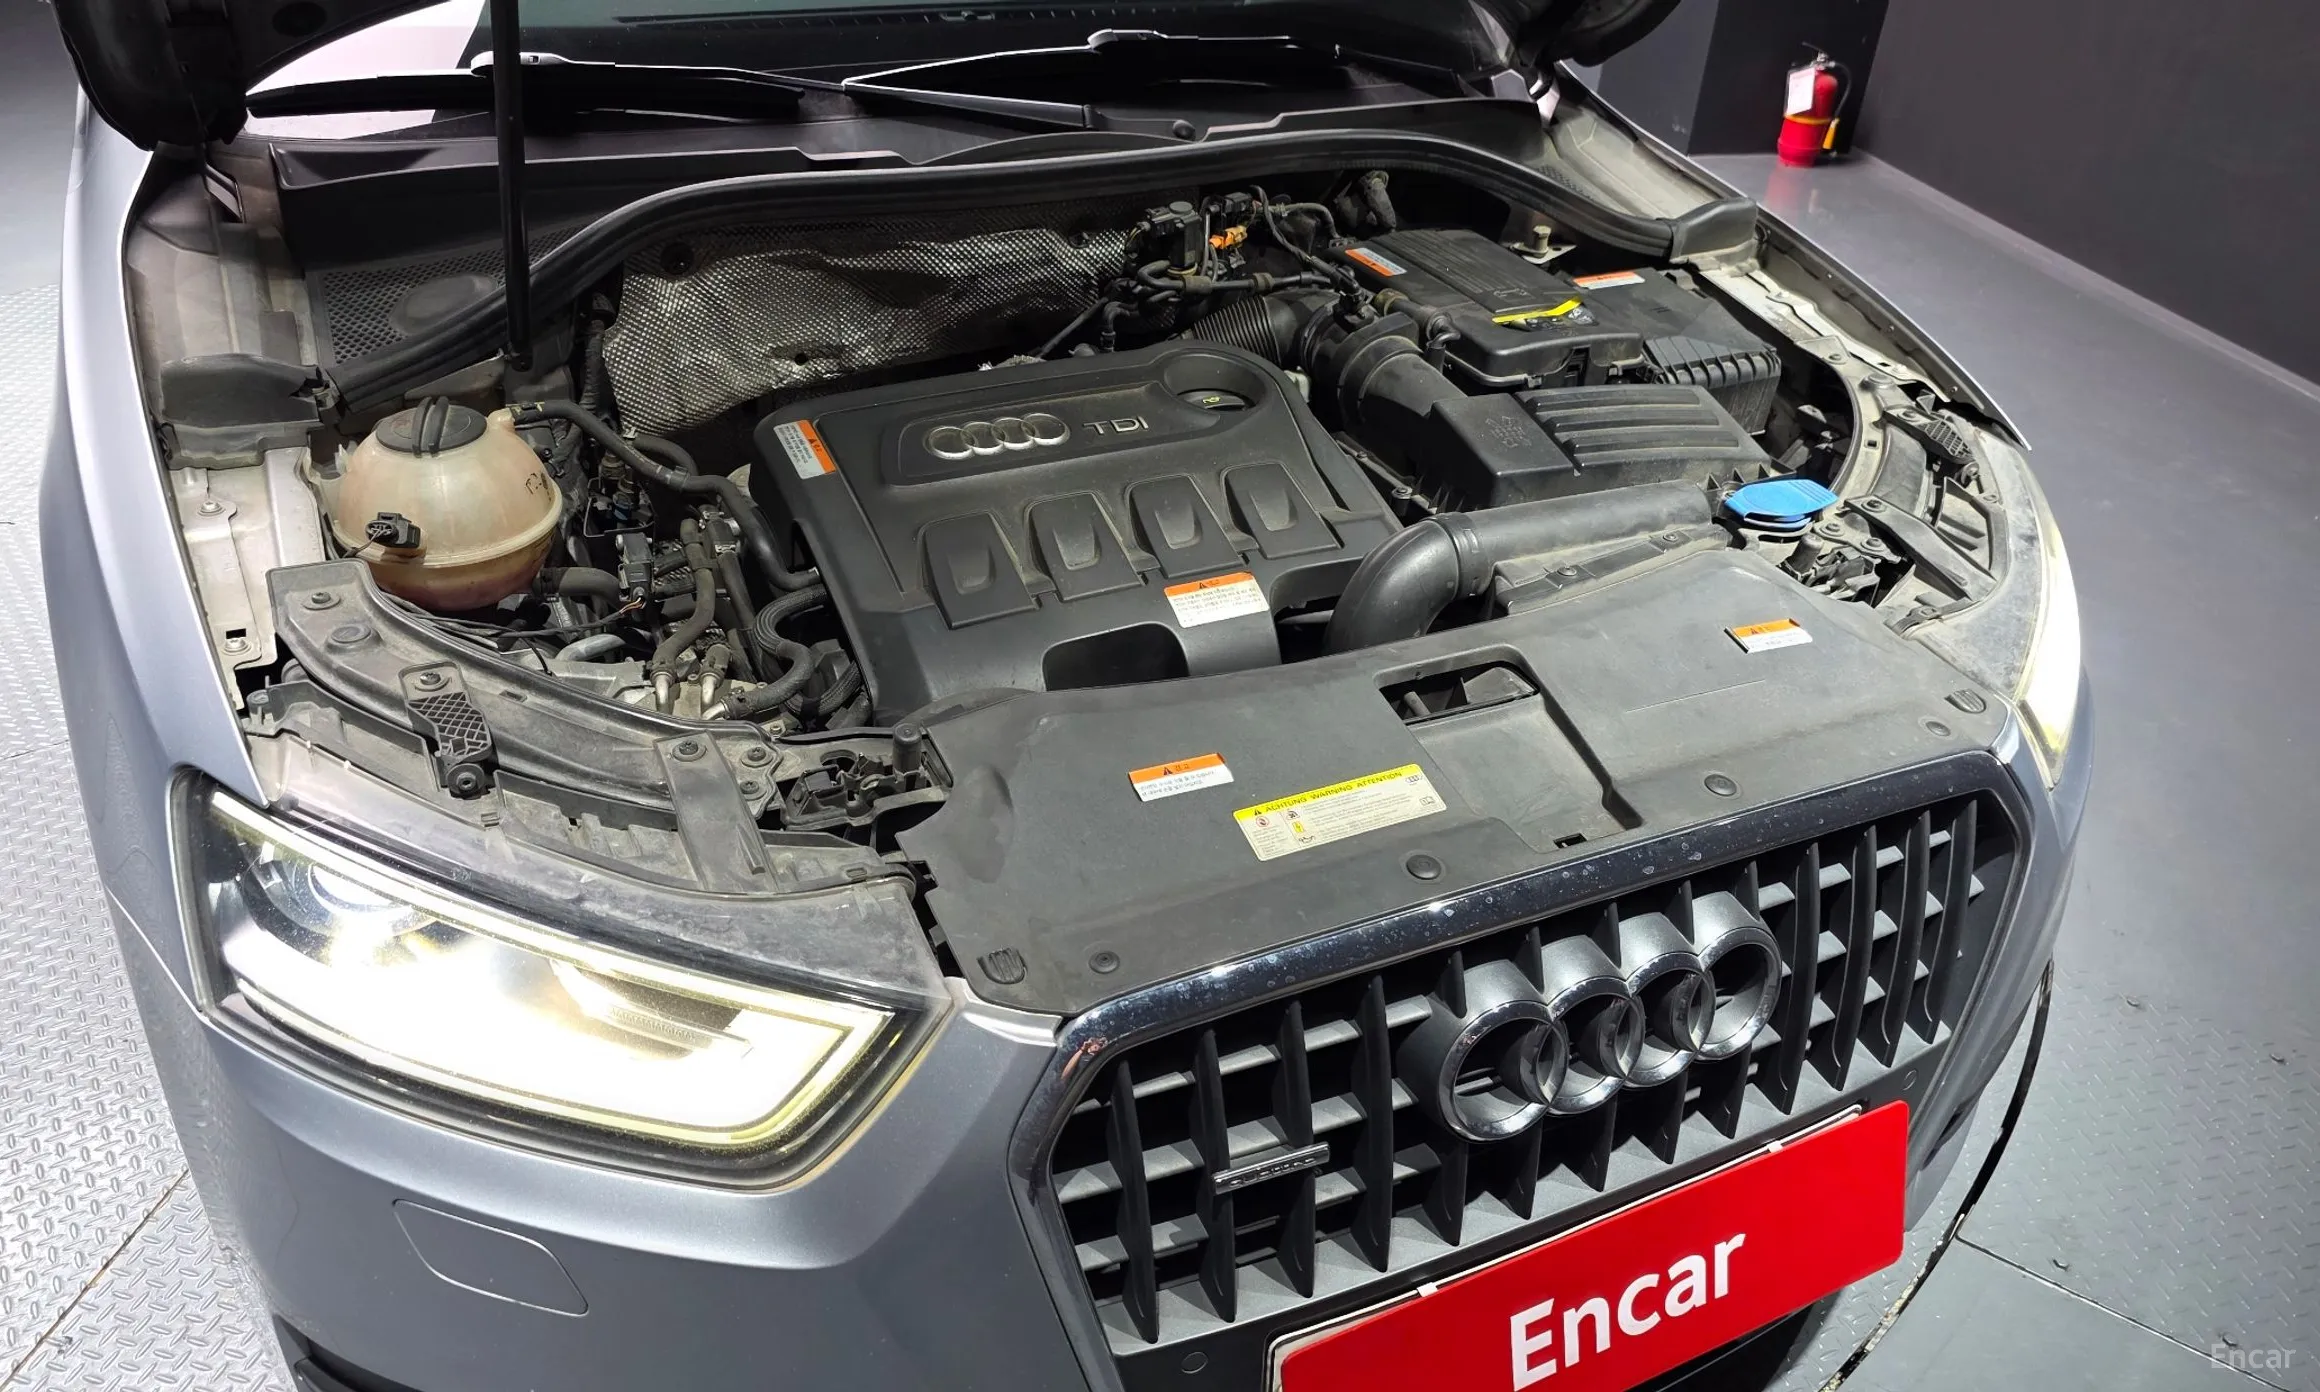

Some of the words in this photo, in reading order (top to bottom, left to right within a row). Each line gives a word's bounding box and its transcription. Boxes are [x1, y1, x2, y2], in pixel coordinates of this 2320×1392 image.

[1083, 415, 1149, 434] TDI
[1265, 796, 1307, 813] ACHTUNG
[1310, 785, 1353, 801] WARNING
[1357, 770, 1402, 789] ATTENTION
[1510, 1233, 1746, 1392] Encar
